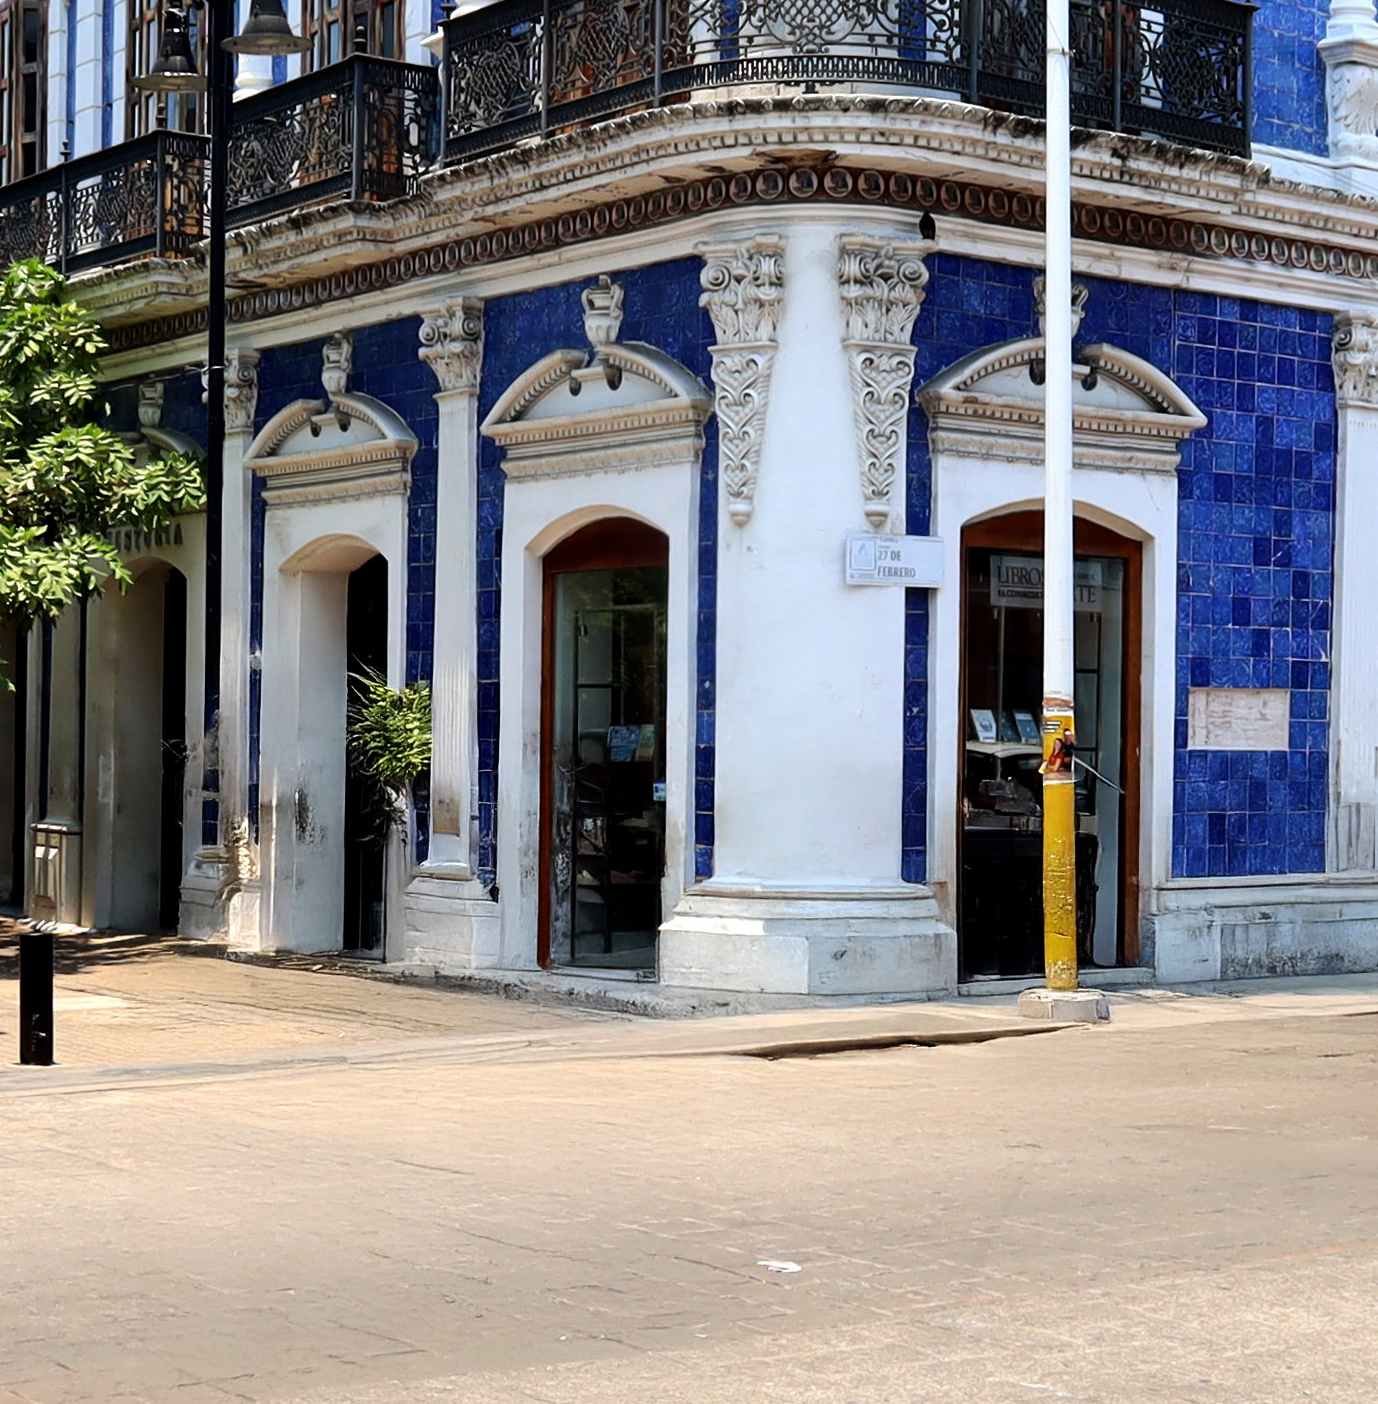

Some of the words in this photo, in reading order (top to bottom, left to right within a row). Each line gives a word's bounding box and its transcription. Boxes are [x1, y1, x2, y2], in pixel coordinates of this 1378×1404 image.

[877, 550, 888, 561] 27
[890, 550, 902, 562] DE
[877, 565, 916, 578] FEBRERO
[997, 564, 1044, 586] LIBRO
